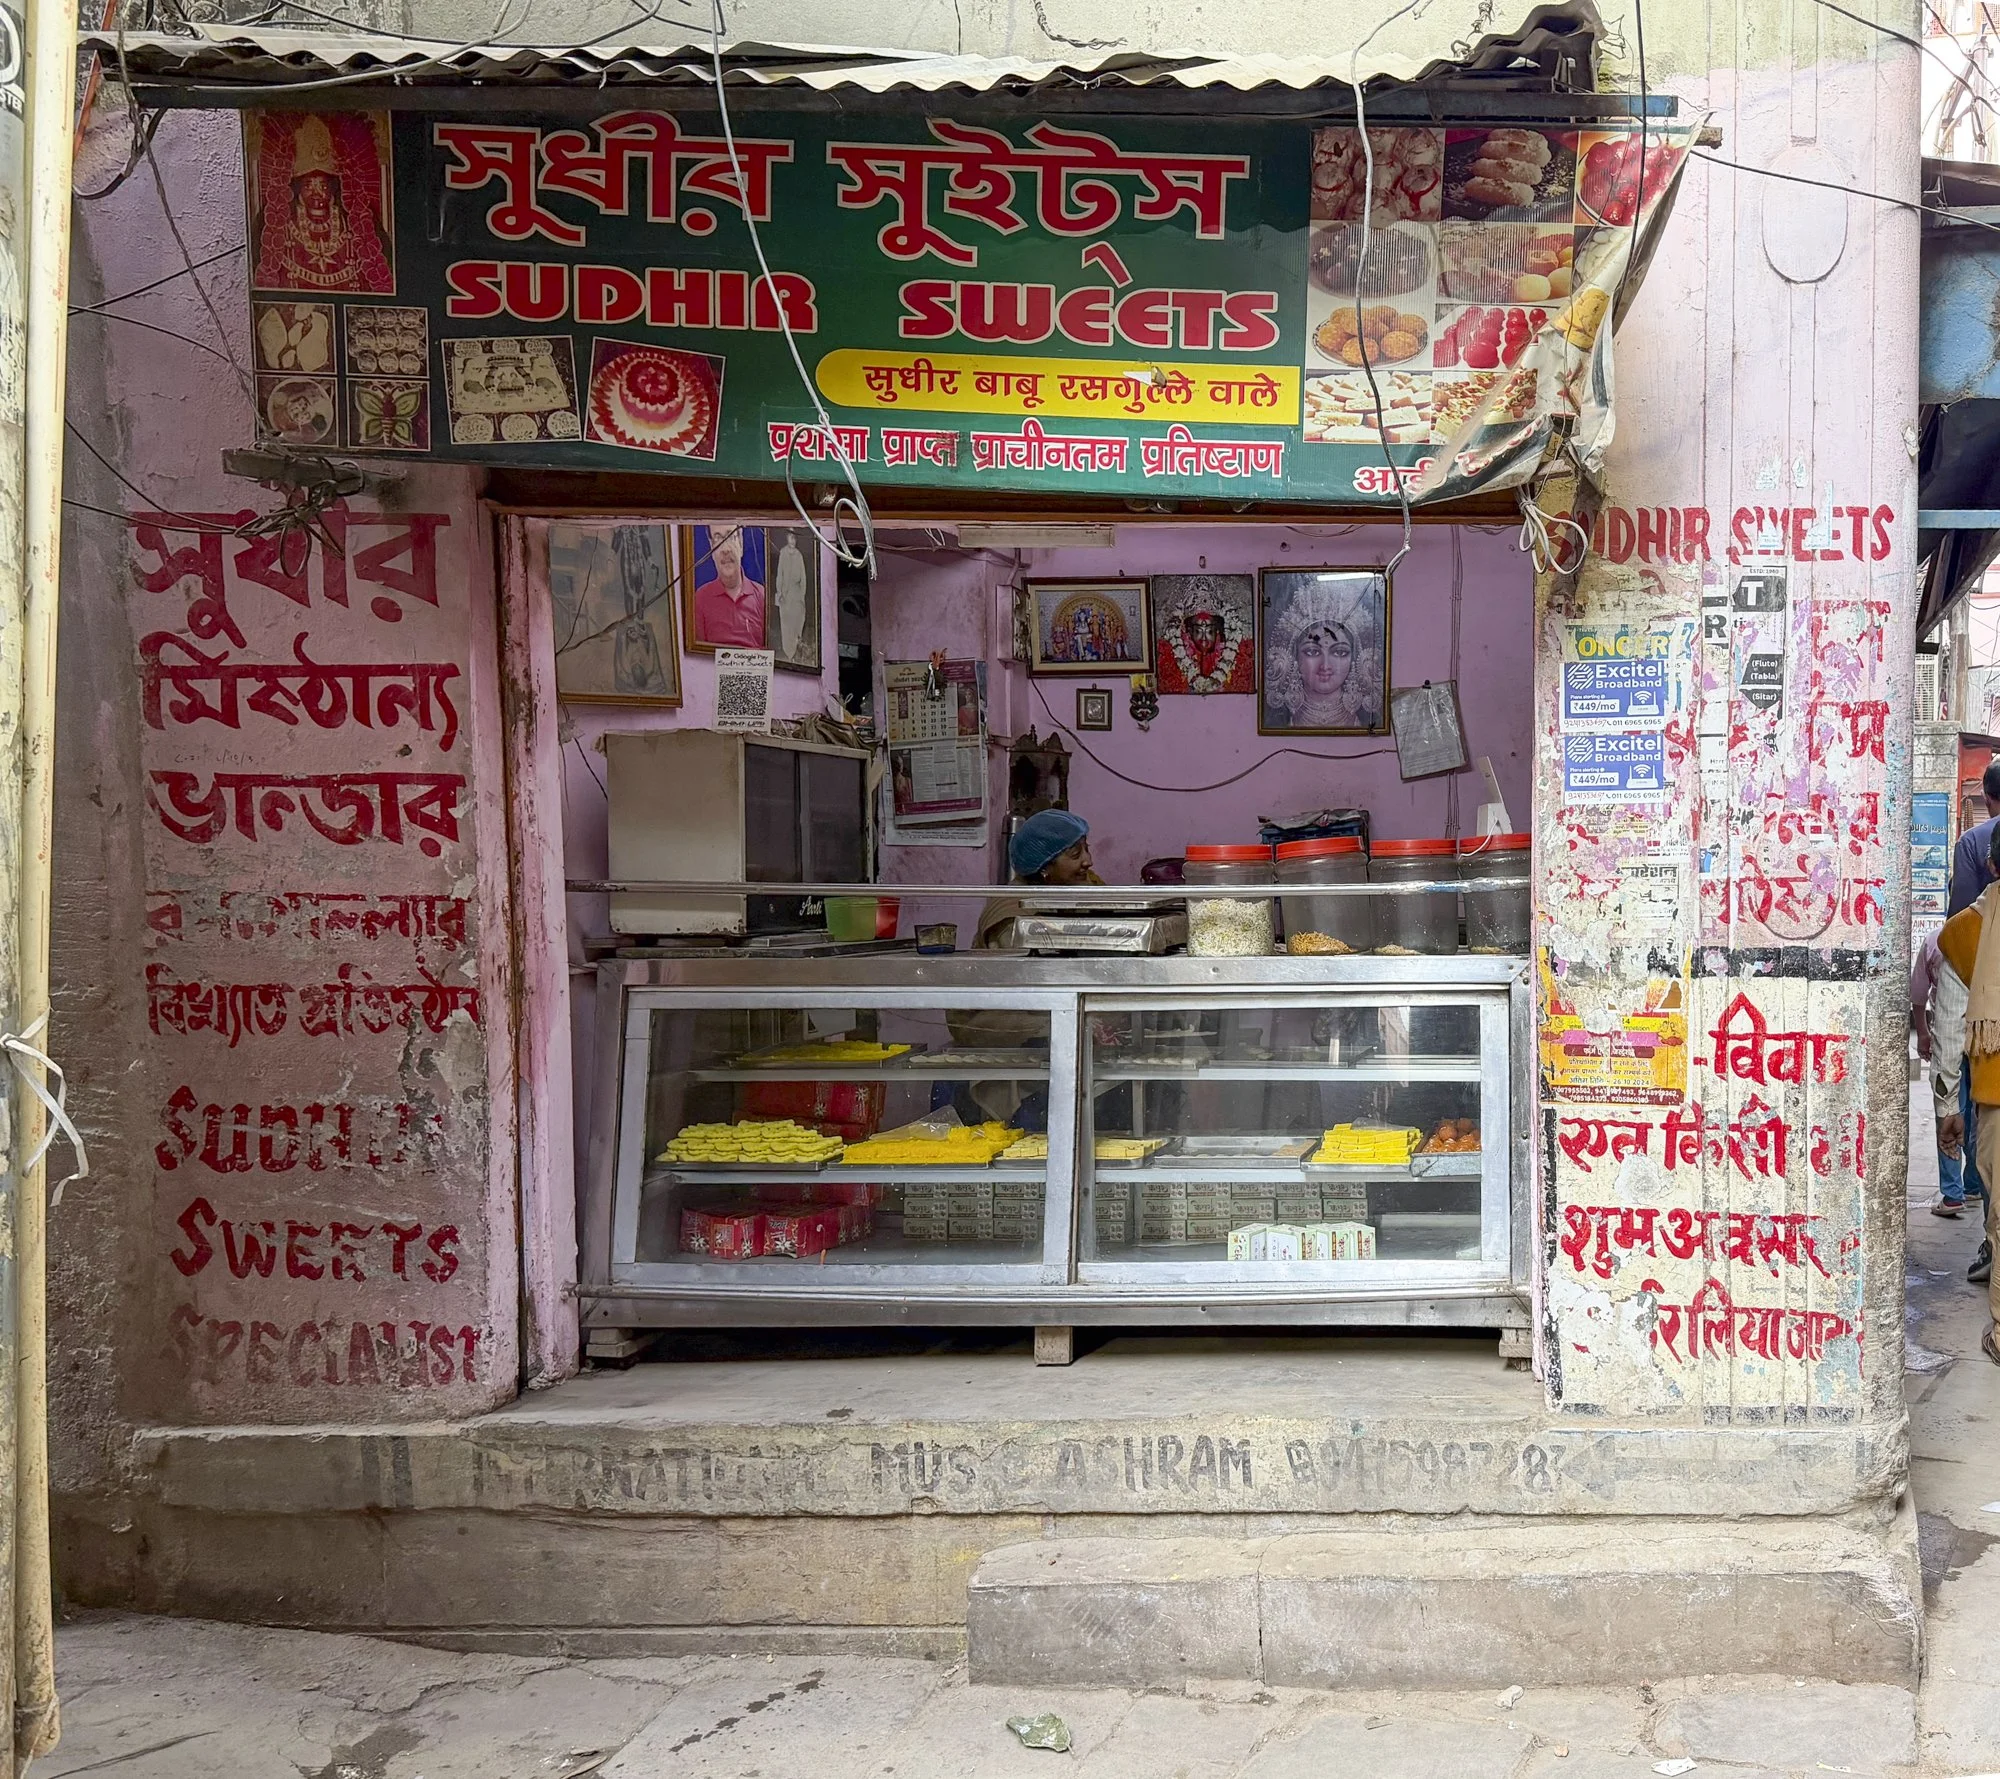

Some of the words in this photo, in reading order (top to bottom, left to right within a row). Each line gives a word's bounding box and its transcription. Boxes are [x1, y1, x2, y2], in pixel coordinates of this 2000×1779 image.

[433, 110, 794, 247] সুধীর
[447, 260, 817, 332] SUDHIR
[898, 266, 1279, 351] SWEETS
[863, 362, 961, 403] सुधीर
[973, 370, 1047, 410] बाबू
[1057, 370, 1195, 413] रसगुल्ले
[1207, 372, 1281, 407] वाले
[971, 417, 1127, 473] प्राचीनतम
[1595, 662, 1662, 679] Excitel
[1595, 678, 1662, 689] Broadband
[1750, 673, 1778, 681] (Tabla)
[1595, 735, 1661, 752] Excitel
[1595, 752, 1661, 763] Broadband
[169, 1196, 460, 1284] SWEETS
[1054, 1435, 1256, 1492] ASHRAM
